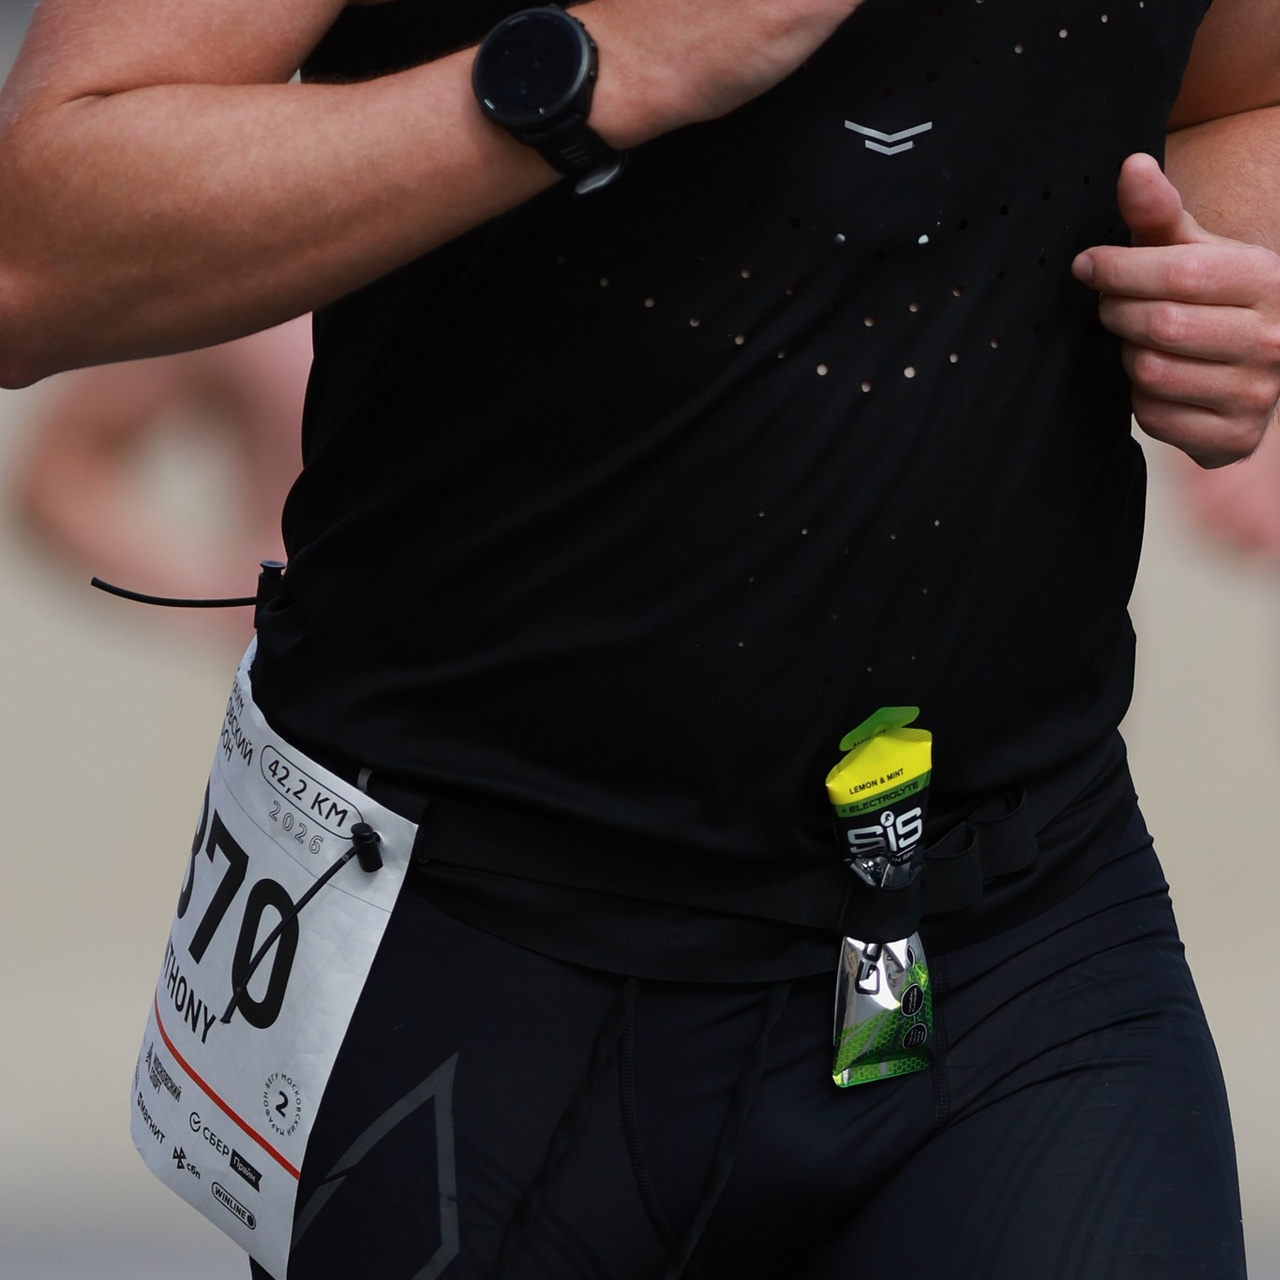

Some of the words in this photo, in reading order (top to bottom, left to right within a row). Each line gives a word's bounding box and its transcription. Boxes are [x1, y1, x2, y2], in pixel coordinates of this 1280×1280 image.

[226, 696, 254, 767] ОВСКИЙ
[268, 759, 307, 800] 42,2
[849, 778, 878, 795] LEMON
[879, 776, 886, 784] &
[887, 767, 904, 781] MINT
[849, 781, 919, 813] ELECTROLYTE
[269, 800, 324, 855] 2026
[275, 1090, 289, 1119] 2
[186, 1163, 201, 1179] сбп
[203, 1127, 230, 1156] СБЕР
[233, 1156, 256, 1183] Прайм
[215, 1185, 246, 1220] WINLINE
